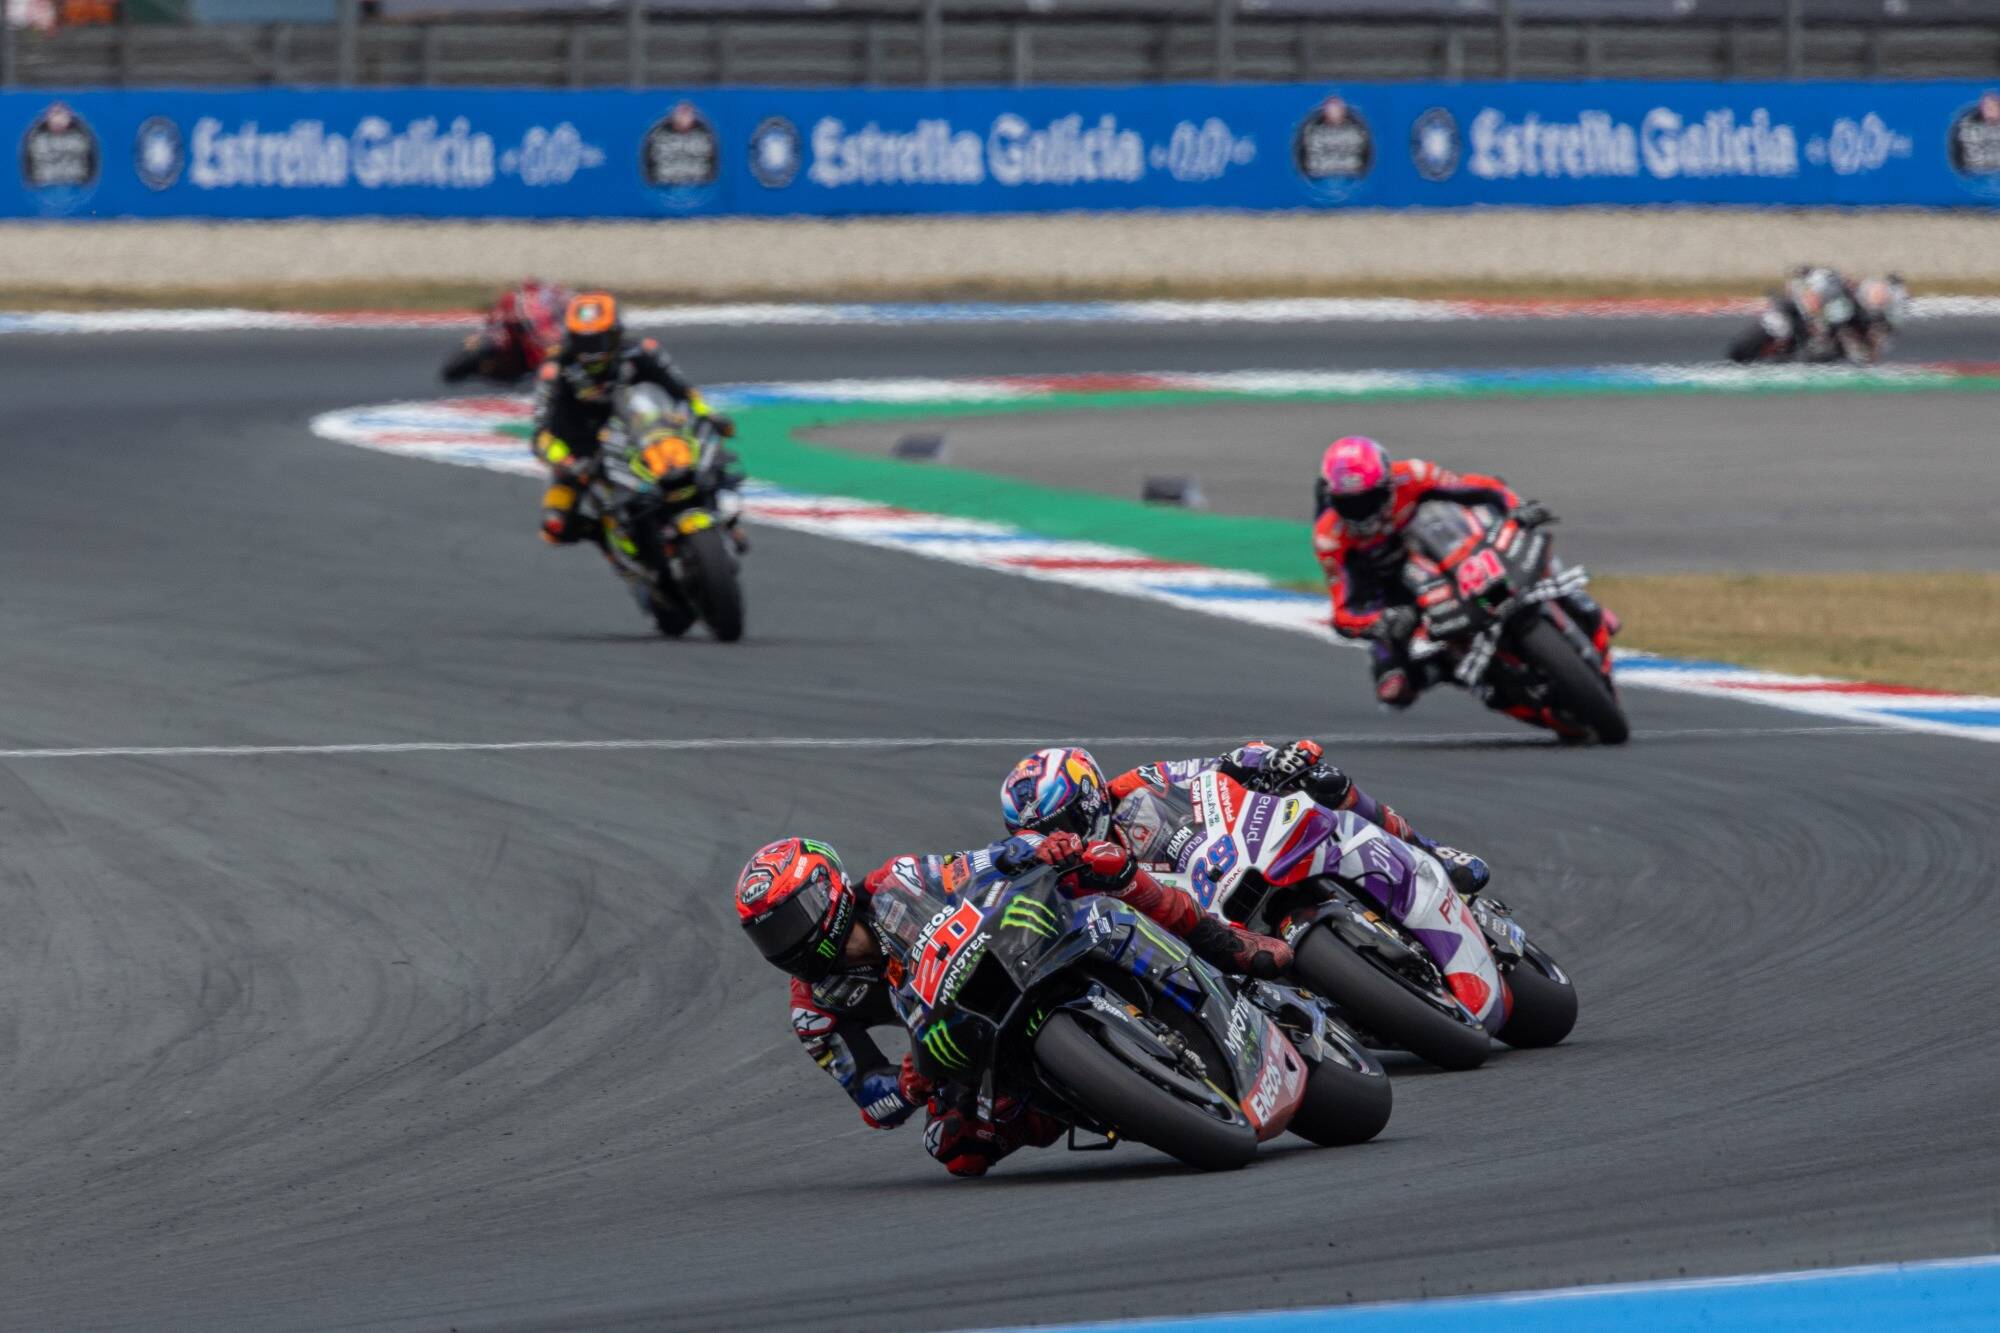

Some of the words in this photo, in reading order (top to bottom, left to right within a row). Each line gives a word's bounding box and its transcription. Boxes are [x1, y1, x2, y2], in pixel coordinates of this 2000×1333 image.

[191, 116, 349, 187] Estrella
[351, 115, 495, 188] Galicia
[810, 115, 984, 187] Estrella
[988, 112, 1144, 185] Galicia
[1470, 107, 1640, 179] Estrella
[1641, 107, 1799, 178] Galicia
[1167, 826, 1193, 859] FIAMM
[1177, 834, 1204, 870] prima
[1247, 795, 1272, 843] prima
[1191, 834, 1239, 910] 89
[909, 897, 984, 1009] 20
[911, 904, 956, 962] ENEOS
[939, 931, 993, 1005] MONSTER
